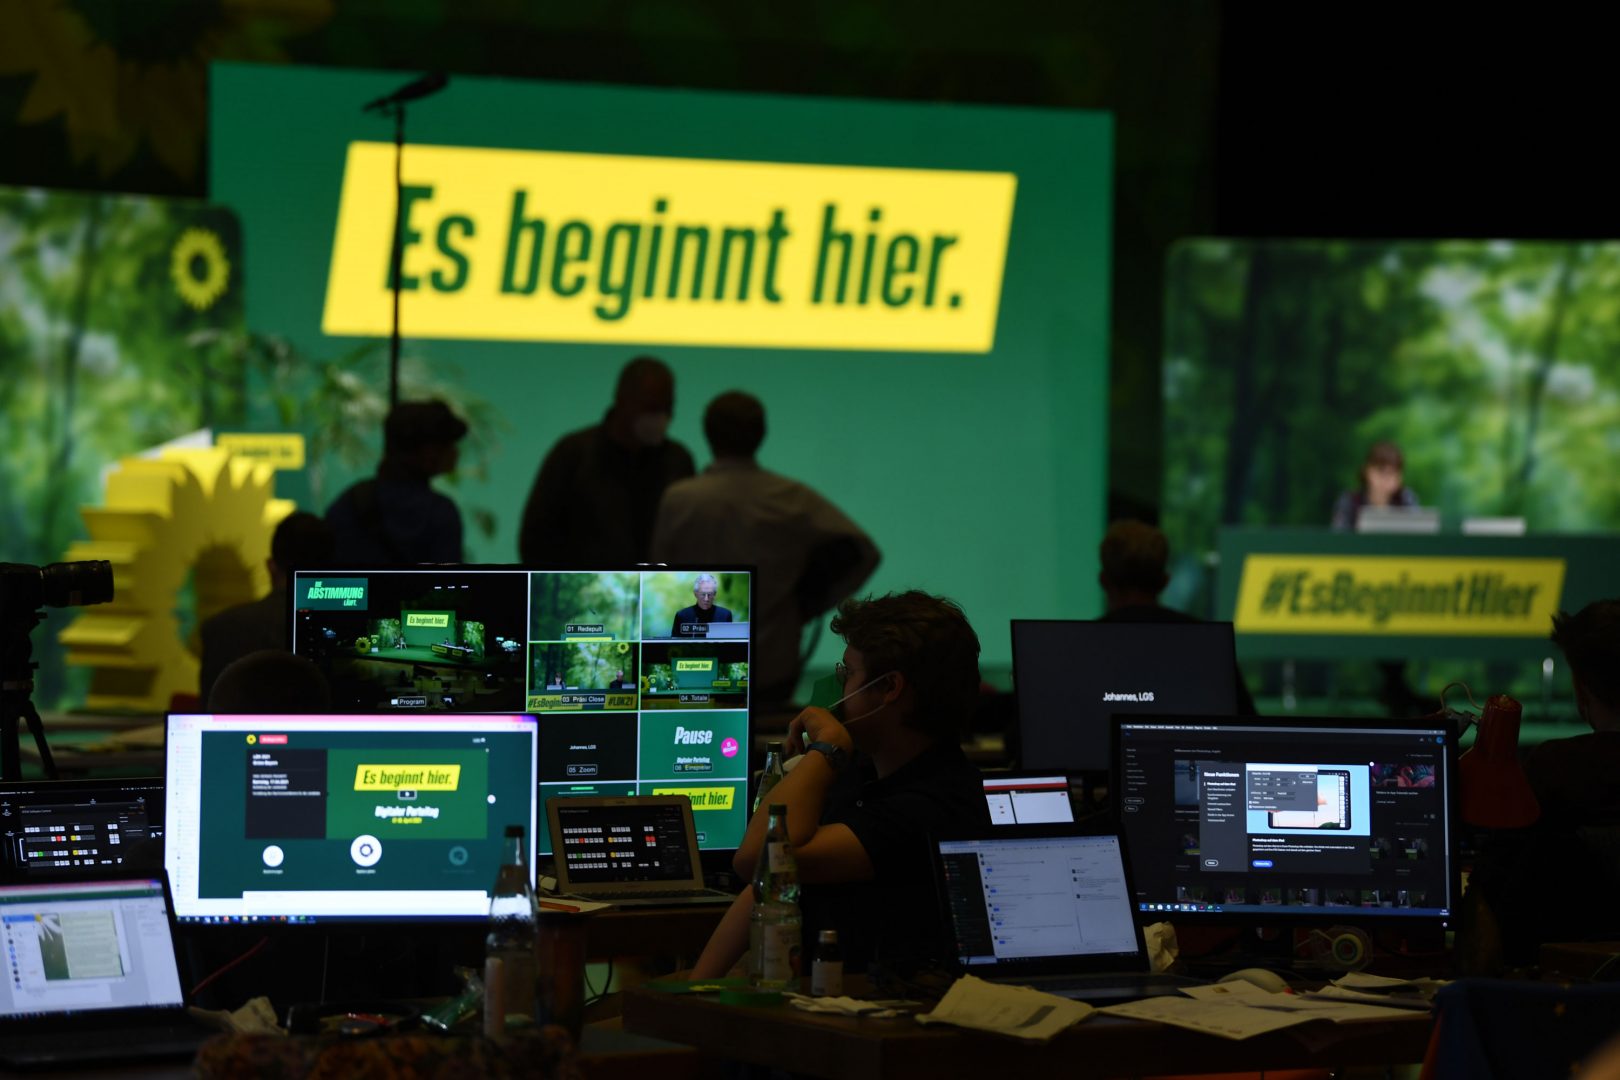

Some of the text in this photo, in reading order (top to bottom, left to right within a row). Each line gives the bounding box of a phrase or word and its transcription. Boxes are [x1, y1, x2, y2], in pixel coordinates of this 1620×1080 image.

[386, 185, 962, 321] Es beginnt hier.
[307, 587, 364, 600] ABSTIMMUNG
[1258, 568, 1541, 625] #EsBeginntHier
[416, 616, 434, 625] beginnt
[577, 625, 602, 633] Redepult
[399, 698, 424, 706] Program
[608, 696, 634, 706] #LDK21
[1102, 692, 1138, 702] Johannes,
[674, 726, 713, 745] Pause
[363, 769, 453, 788] Es beginnt hier.
[708, 791, 729, 805] hier.
